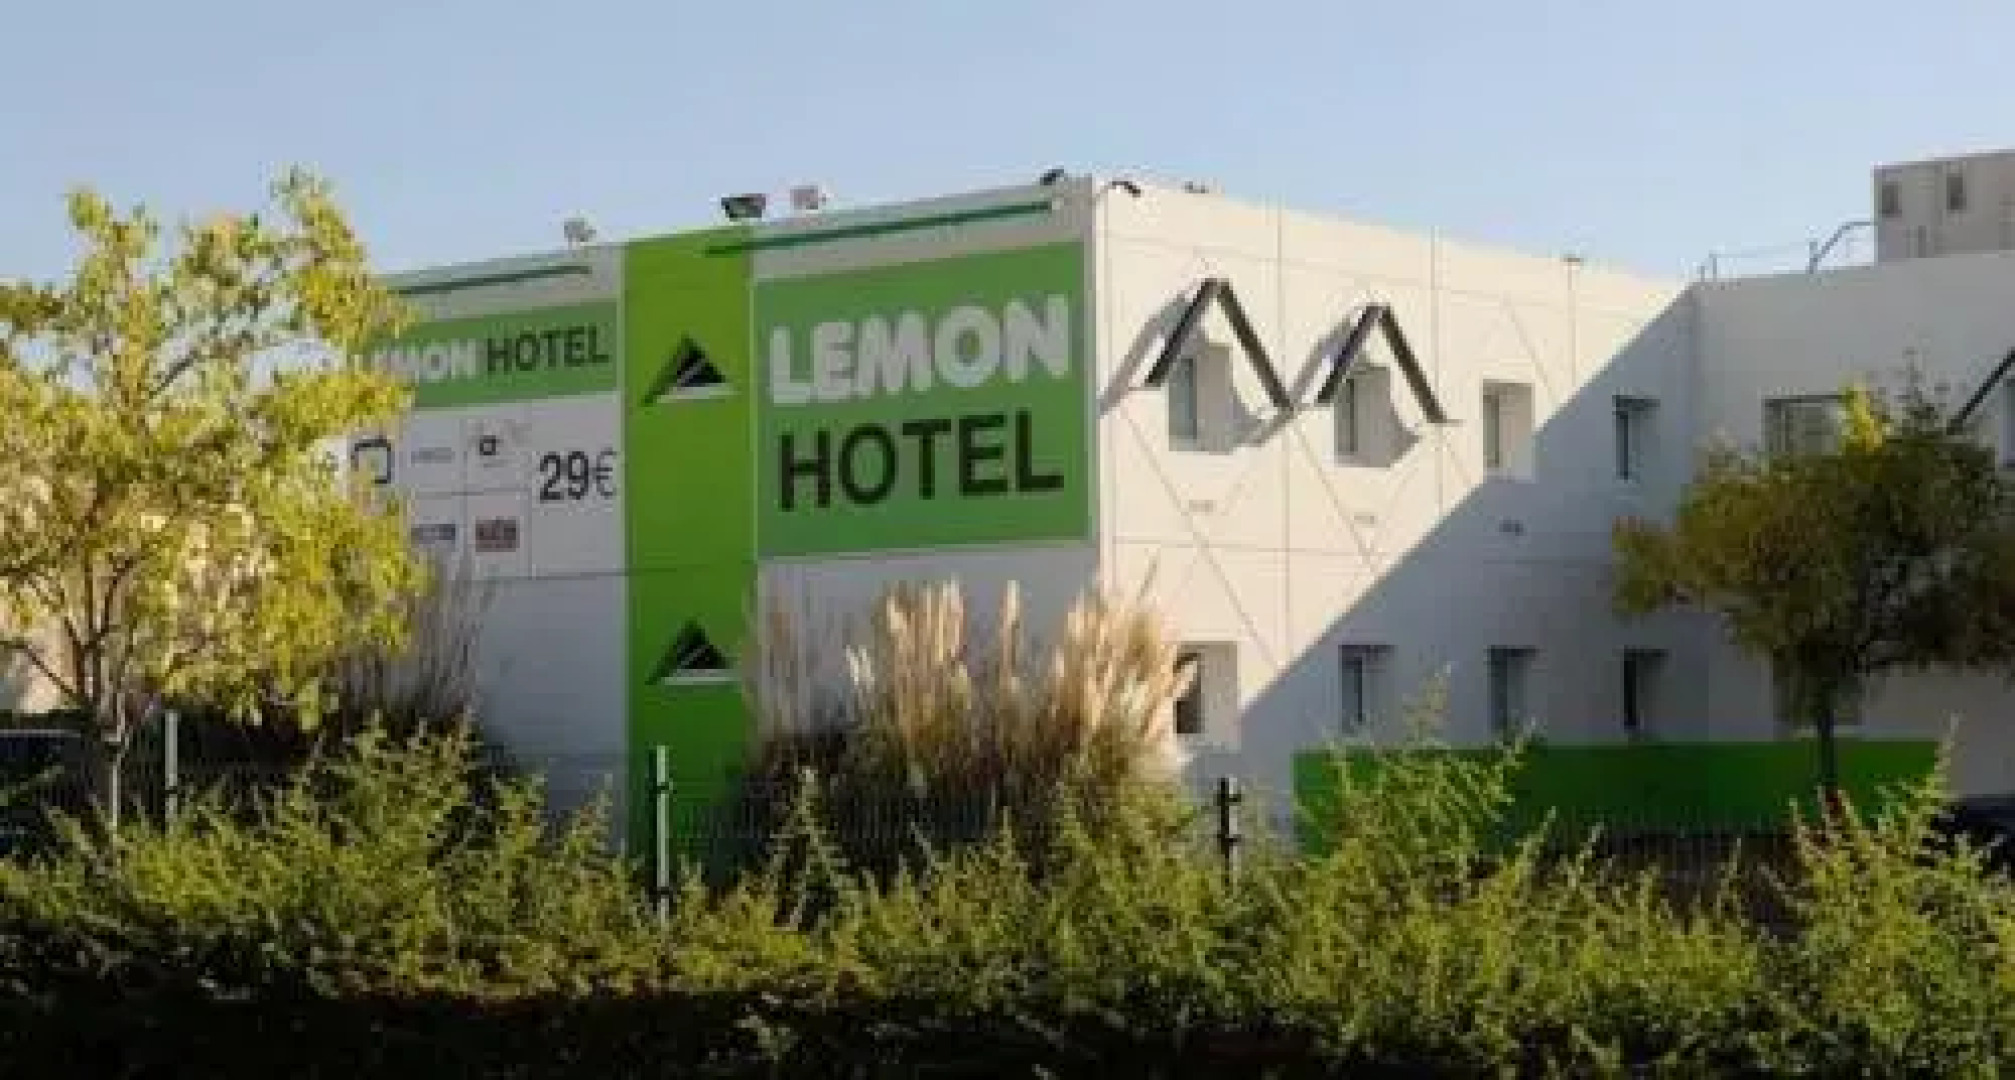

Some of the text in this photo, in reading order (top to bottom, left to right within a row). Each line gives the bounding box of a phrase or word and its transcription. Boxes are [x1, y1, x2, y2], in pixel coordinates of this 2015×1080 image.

[486, 324, 610, 374] HOTEL
[770, 293, 1070, 406] LEMON
[538, 448, 617, 502] 29€
[778, 410, 1065, 512] HOTEL
